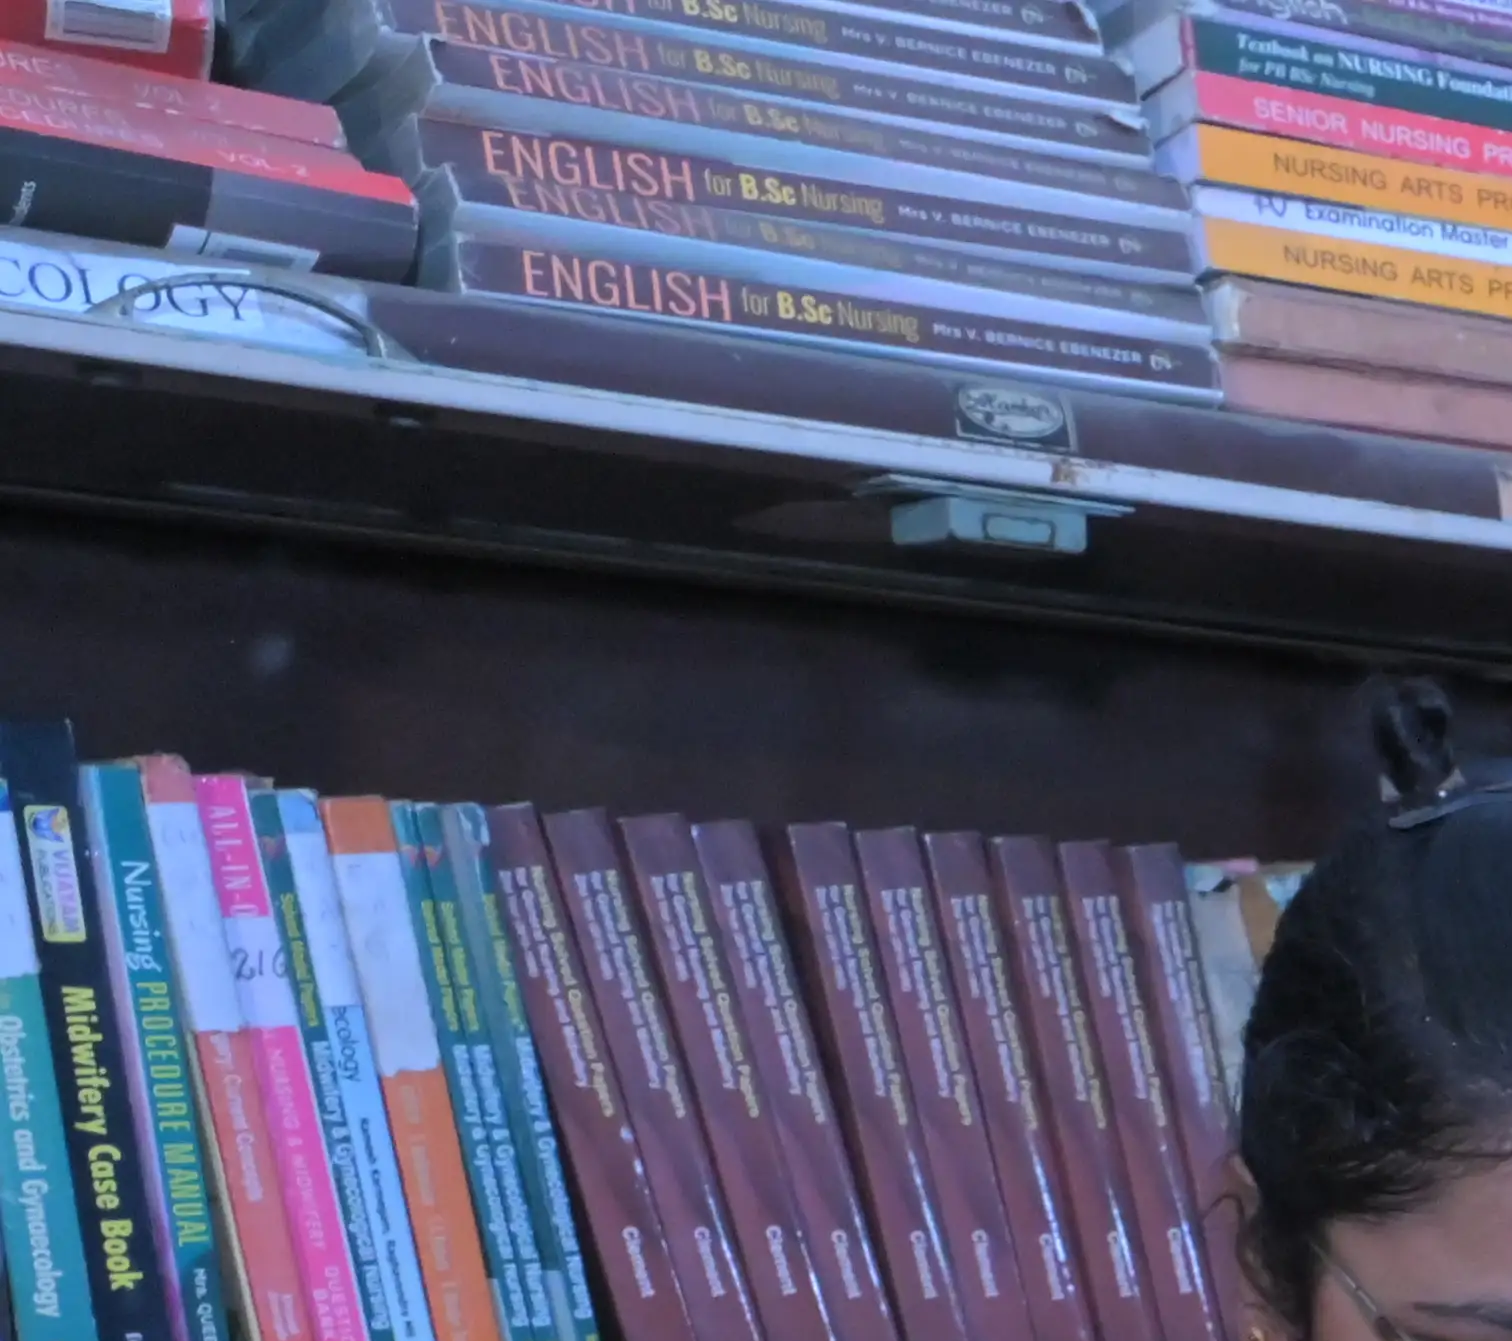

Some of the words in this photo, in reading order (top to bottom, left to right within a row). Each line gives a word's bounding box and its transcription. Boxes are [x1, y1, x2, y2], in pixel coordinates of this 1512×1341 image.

[435, 0, 650, 71] ENGLISH
[694, 49, 752, 80] B.Sc
[1337, 51, 1434, 85] NURSING
[489, 53, 701, 122] ENGLISH
[1253, 98, 1348, 135] SENIOR
[1361, 119, 1470, 158] NURSING
[481, 129, 695, 201] ENGLISH
[703, 167, 732, 196] for
[739, 174, 797, 206] B.Sc
[800, 184, 885, 225] Nursing
[951, 212, 1023, 236] BERNICE
[1028, 223, 1111, 248] EBENEZER
[1273, 152, 1386, 191] NURSING
[1400, 176, 1464, 205] ARTS
[1304, 202, 1434, 240] Examination
[1440, 223, 1508, 249] Master
[521, 249, 732, 322] ENGLISH
[741, 287, 770, 315] for
[776, 292, 833, 325] B.Sc
[836, 303, 920, 343] Nursing
[933, 322, 962, 340] Mrs
[985, 331, 1055, 353] BERNICE
[1059, 340, 1143, 365] EBENEZER
[1282, 245, 1399, 281] NURSING
[1411, 267, 1475, 295] ARTS
[119, 860, 162, 972] Nursing
[1, 1015, 35, 1122] Obstetrics
[61, 985, 112, 1136] Midwifery
[135, 982, 191, 1134] PROCEDURE
[13, 1128, 47, 1172] and
[87, 1145, 122, 1210] Case
[162, 1142, 211, 1248] MANUAL
[18, 1179, 63, 1319] Gynaecology
[99, 1218, 144, 1292] Book
[621, 1225, 656, 1299] Clement
